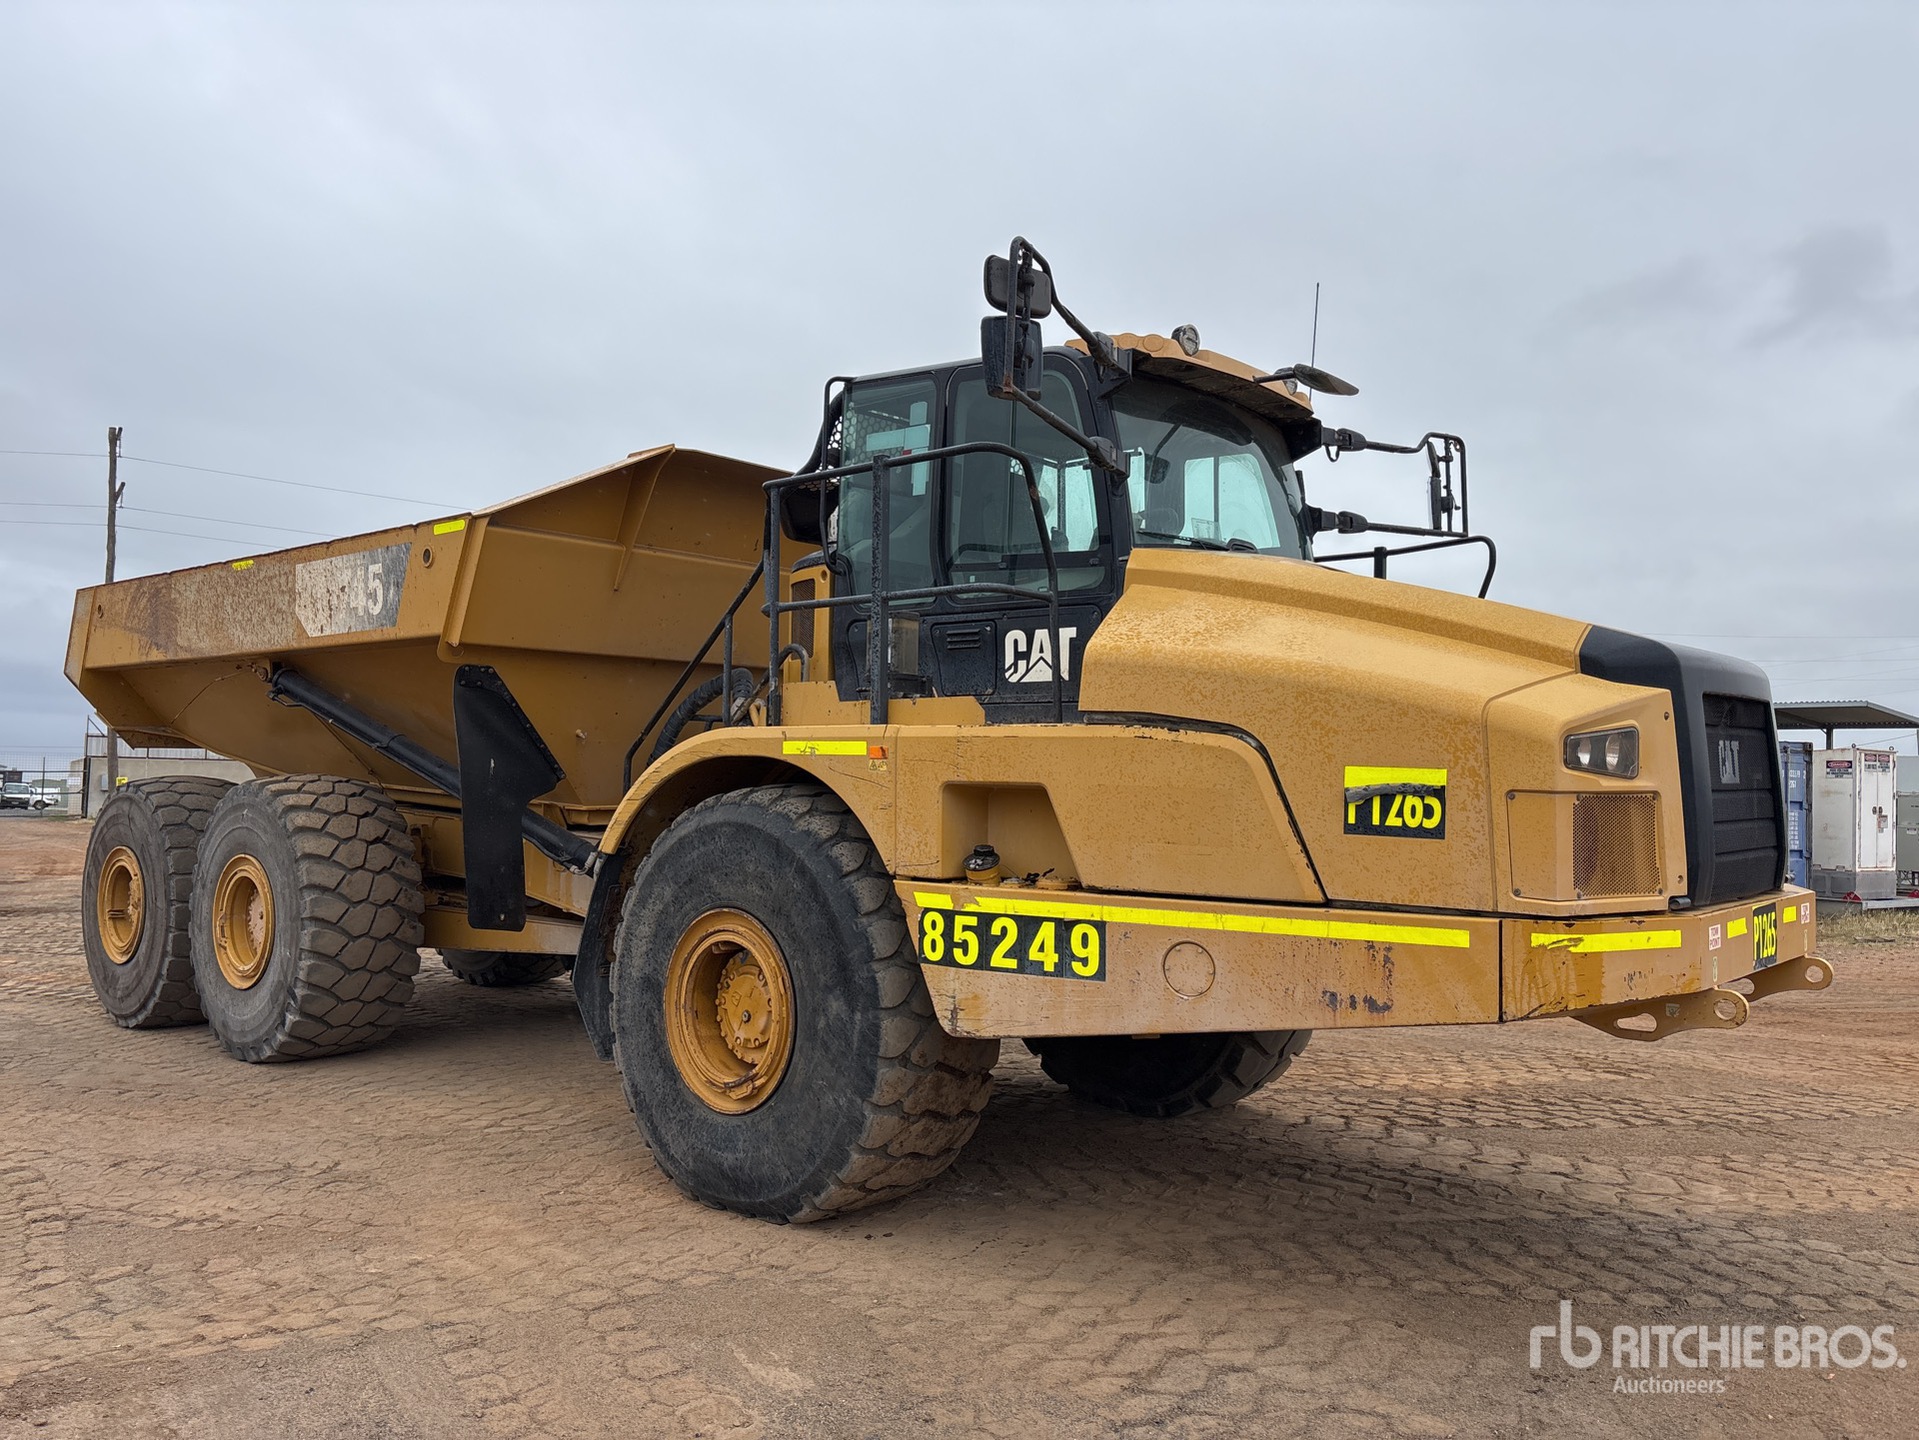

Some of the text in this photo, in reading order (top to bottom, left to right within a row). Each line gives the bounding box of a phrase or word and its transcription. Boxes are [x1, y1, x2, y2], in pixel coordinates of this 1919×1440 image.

[1004, 627, 1077, 682] CAT
[923, 911, 1100, 977] 85249
[1753, 912, 1776, 961] P1265
